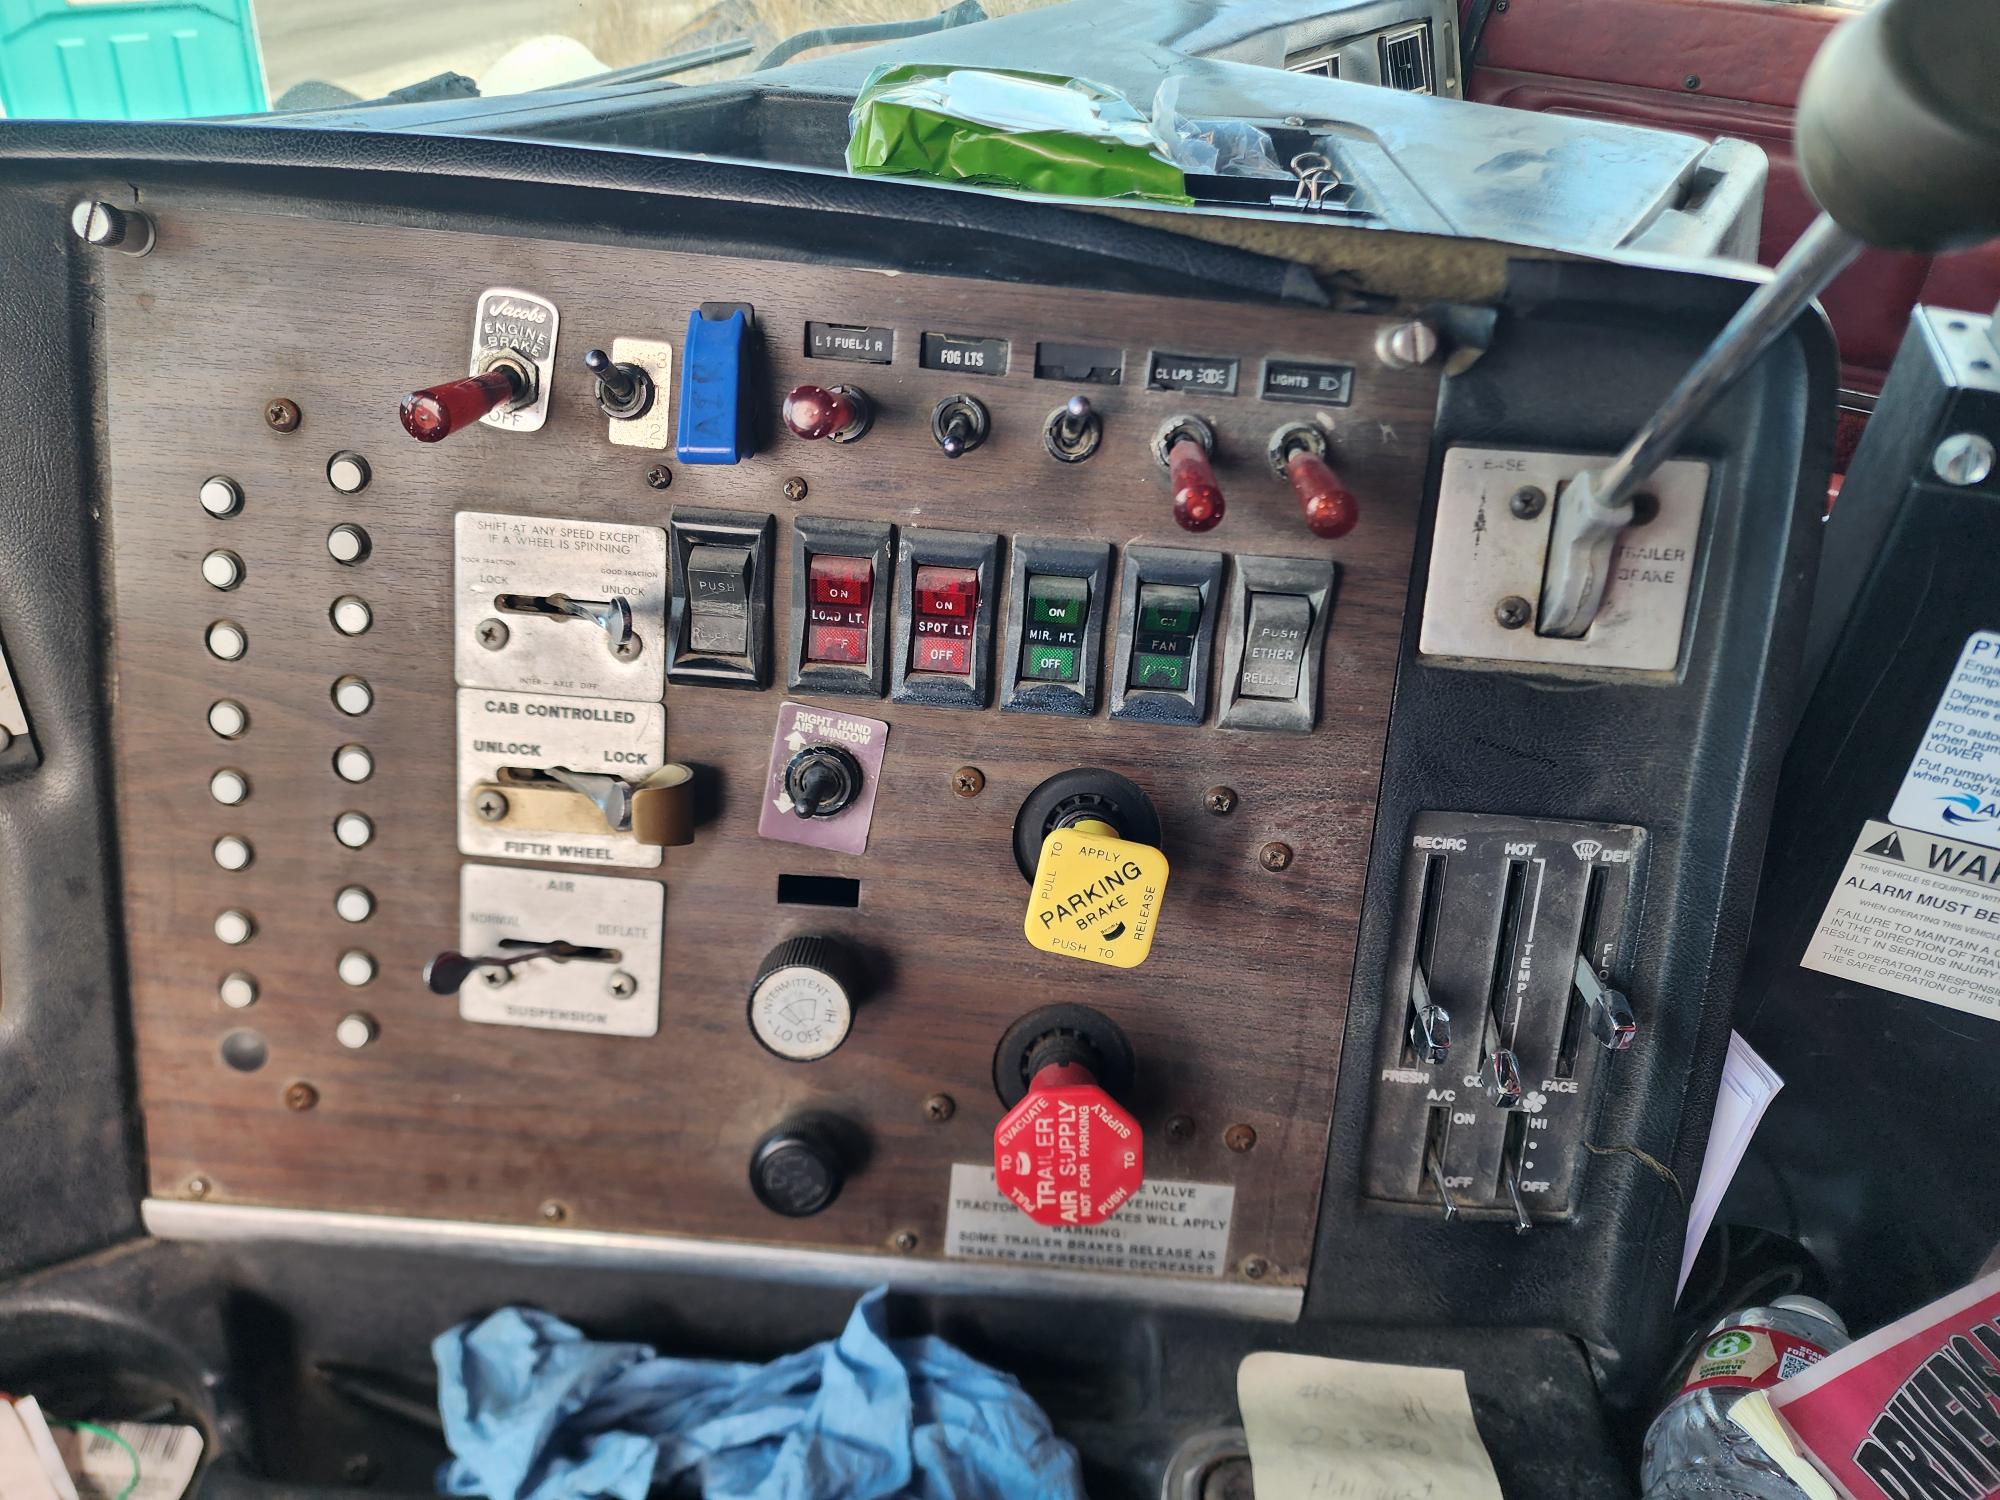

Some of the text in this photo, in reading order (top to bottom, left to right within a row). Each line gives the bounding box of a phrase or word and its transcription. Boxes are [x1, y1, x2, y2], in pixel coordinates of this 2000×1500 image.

[489, 300, 547, 323] Jacobs
[485, 322, 548, 346] ENGINE
[488, 336, 542, 357] BRAKE
[815, 336, 883, 352] L FUEL R
[657, 352, 667, 369] 3
[941, 350, 984, 367] FOG LTS
[1155, 368, 1193, 381] CL LPS
[1270, 374, 1309, 388] LIGHTS
[489, 409, 523, 426] OFF
[650, 424, 661, 440] 2
[478, 520, 641, 544] SHIFT AT ANY SPEED EXCEPT
[489, 534, 631, 555] IF A WHEEL IS SPINNING
[480, 574, 510, 585] LOCK
[601, 568, 658, 578] GOOD TRACTION
[601, 584, 646, 597] UNLOCK
[700, 581, 735, 592] PUSH
[829, 589, 849, 598] ON
[936, 601, 953, 610] ON
[1049, 607, 1066, 618] ON
[848, 613, 865, 624] LT.
[918, 621, 971, 636] SPOT LT.
[1059, 631, 1077, 643] HT.
[1262, 628, 1298, 639] PUSH
[1151, 640, 1177, 652] FAN
[1252, 647, 1294, 660] ETHER
[930, 649, 954, 661] OFF
[1041, 658, 1062, 669] OFF
[485, 700, 636, 724] CAB CONTROLLED
[1944, 701, 1990, 719] before
[795, 711, 872, 735] RIGHT HAND
[1935, 720, 1965, 734] PTO
[792, 721, 872, 745] AIR WINDOW
[1931, 732, 1968, 747] when
[473, 739, 649, 766] UNLOCK LOCK
[1925, 741, 1984, 762] LOWER
[1918, 758, 1942, 772] Put
[1913, 770, 1989, 795] when body
[504, 841, 615, 861] FIFTH WHEEL
[1413, 836, 1468, 851] RECIRC
[1504, 842, 1537, 856] HOT
[1042, 841, 1121, 900] PULL TO APPLY
[546, 880, 576, 893] AIR
[1860, 863, 1980, 898] THIS VEHICLE IS EQUIPPED
[1039, 861, 1143, 930] PARKING
[1844, 876, 2000, 924] ALARM MUST BE
[470, 911, 520, 928] NORMAL
[1075, 894, 1129, 931] BRAKE
[1860, 899, 1887, 912] WHEN
[1887, 906, 1941, 926] OPERATING
[1941, 919, 1963, 932] THIS
[1052, 937, 1088, 953] PUSH
[1098, 947, 1114, 959] TO
[1133, 885, 1156, 941] RELEASE
[596, 923, 649, 940] DEFLATE
[1830, 918, 1967, 961] IN THE DIRECTION OF
[1836, 908, 1893, 928] FAILURE
[1894, 922, 1913, 934] TO
[1914, 928, 1980, 952] MAINTAIN
[1980, 946, 1990, 955] A
[1820, 926, 1999, 979] RESULT IN SERIOUS INJURY
[1516, 943, 1534, 994] TEMP
[1833, 944, 1936, 979] THE OPERATOR IS
[1822, 951, 1996, 1005] THE SAFE OPERATION OF THIS
[764, 978, 831, 1015] INTERMITTENT
[506, 1005, 608, 1025] SUSPENSION
[824, 1009, 838, 1023] HI
[774, 1026, 793, 1042] LO
[796, 1025, 823, 1044] OFF
[1381, 1069, 1430, 1085] FRESH
[1427, 1088, 1456, 1102] A/C
[1541, 1080, 1579, 1094] FACE
[1453, 1112, 1476, 1125] ON
[1530, 1118, 1548, 1130] HI
[998, 1097, 1050, 1213] PULL TO EVACUATE
[1035, 1117, 1057, 1210] TRAILER
[1057, 1099, 1078, 1223] AIR SUPPLY
[1078, 1105, 1092, 1217] NOT FOR PARKING
[1091, 1103, 1136, 1216] PUSH TO SUPPLY
[1444, 1176, 1474, 1189] OFF
[1520, 1181, 1550, 1194] OFF
[1152, 1184, 1197, 1199] VALVE
[1126, 1199, 1187, 1213] VEHICLE
[1146, 1214, 1227, 1231] WILL APPLY
[960, 1231, 1217, 1260] SOME TRAILER BRAKES RELEASE AS
[1022, 1250, 1044, 1261] AIR
[1050, 1253, 1124, 1269] PRESSURE
[1129, 1258, 1215, 1274] DECREASES
[1787, 1347, 1806, 1358] FOR
